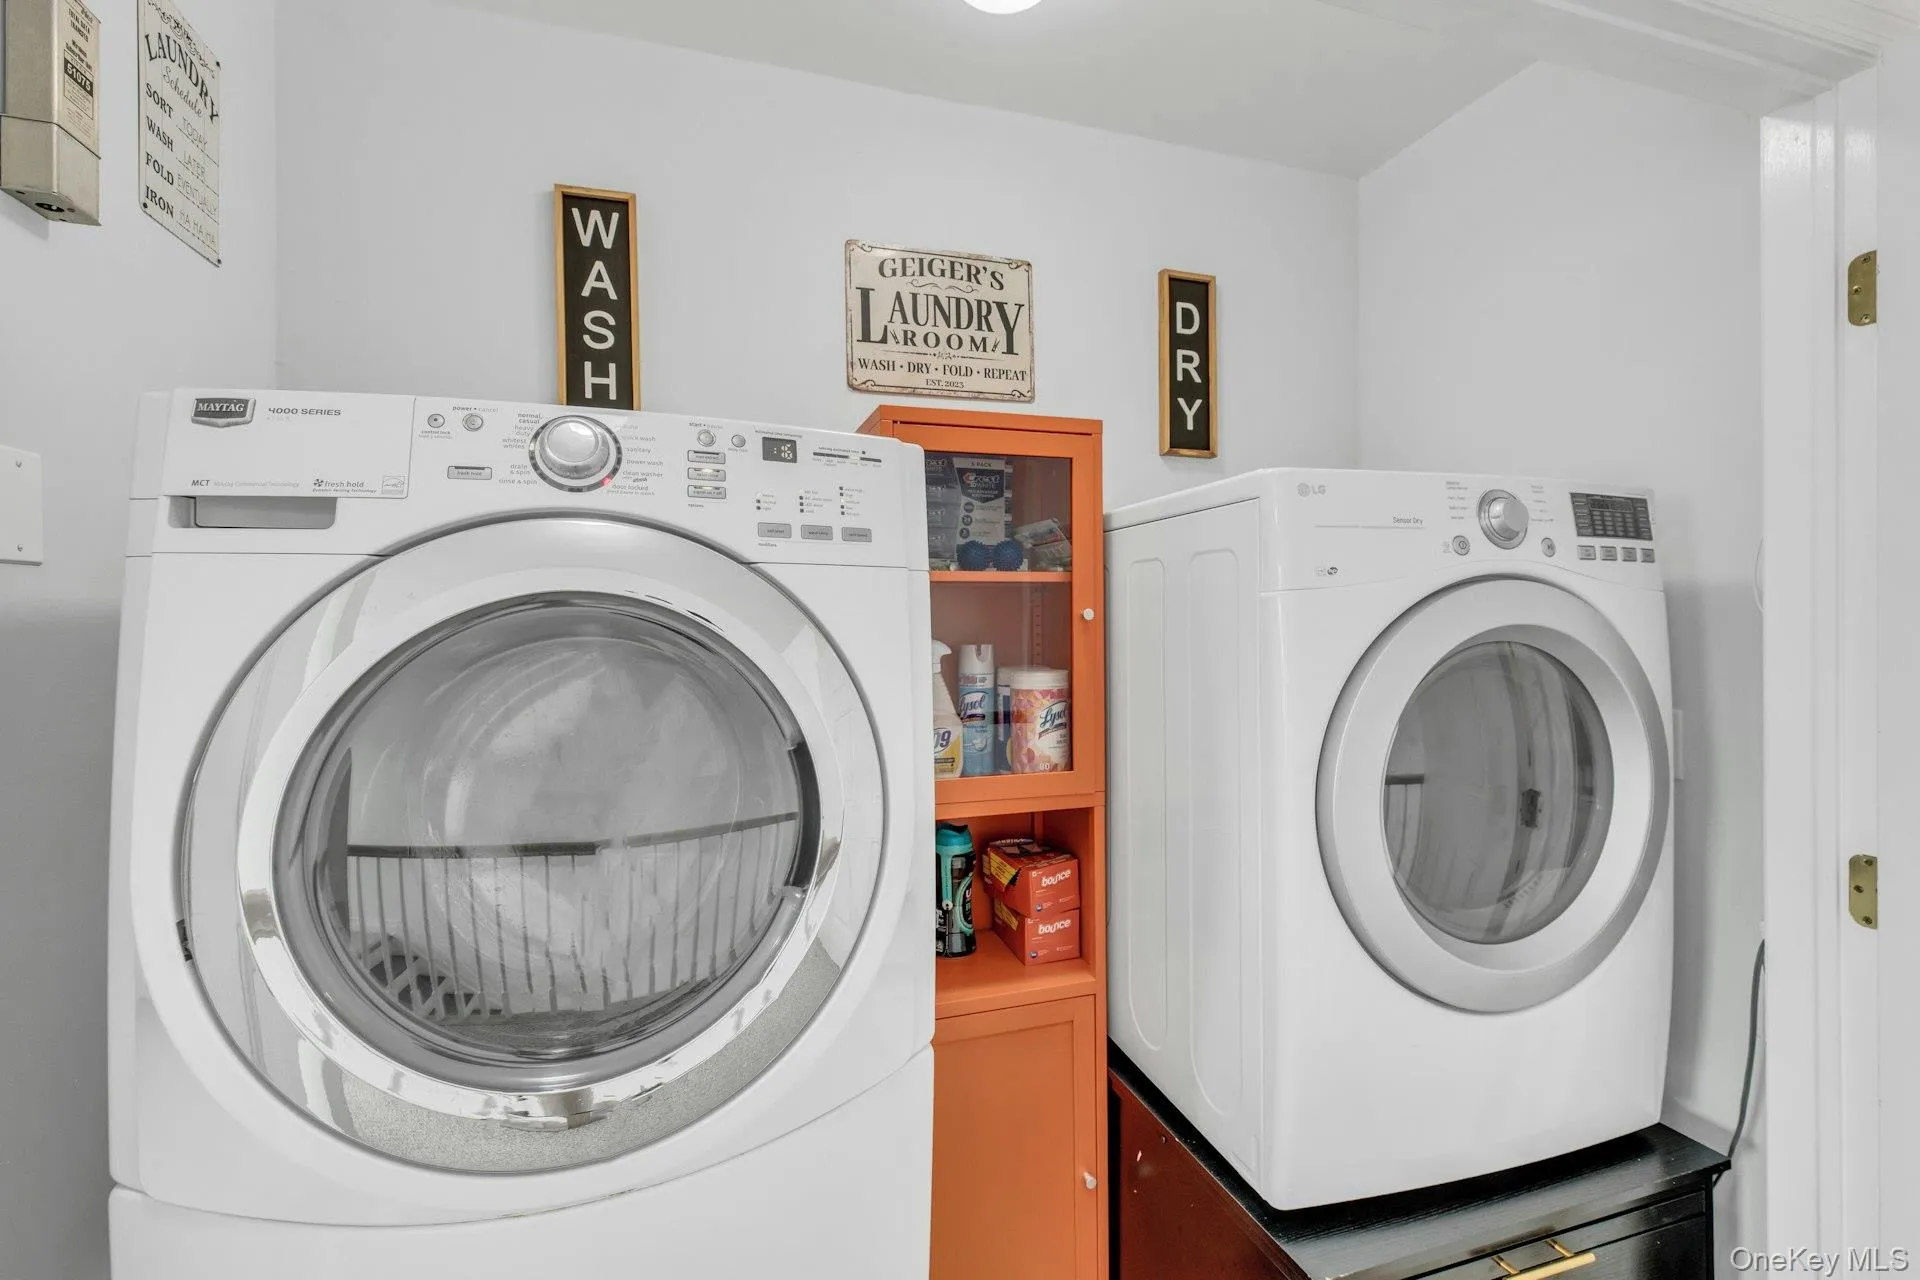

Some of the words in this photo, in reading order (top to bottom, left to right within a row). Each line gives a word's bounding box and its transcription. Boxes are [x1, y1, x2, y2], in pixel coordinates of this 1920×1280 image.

[66, 62, 91, 91] 51075
[145, 32, 219, 124] LAUNDRY
[145, 82, 174, 119] SORT
[163, 66, 202, 117] Schedule
[145, 114, 174, 152] WASH
[145, 151, 174, 186] FOLD
[145, 184, 174, 219] IRON
[878, 257, 1005, 291] GEIGER'S
[571, 207, 620, 400] WASH
[855, 286, 1025, 356] LAUNDRY
[902, 329, 989, 353] ROOM
[857, 358, 896, 372] WASH
[907, 361, 932, 375] DRY
[943, 365, 973, 378] FOLD
[983, 368, 1027, 382] REPEAT
[1175, 301, 1203, 431] DRY
[926, 378, 944, 387] EST.
[945, 380, 964, 389] 2023
[197, 403, 245, 412] MAYTAG
[268, 407, 298, 415] 4000
[300, 408, 341, 416] SERIES
[324, 480, 345, 488] fresh
[1313, 485, 1326, 495] LG
[1393, 516, 1412, 524] Sensor
[1413, 517, 1423, 525] Dry
[1041, 869, 1071, 887] bounce
[1039, 919, 1071, 934] bounce
